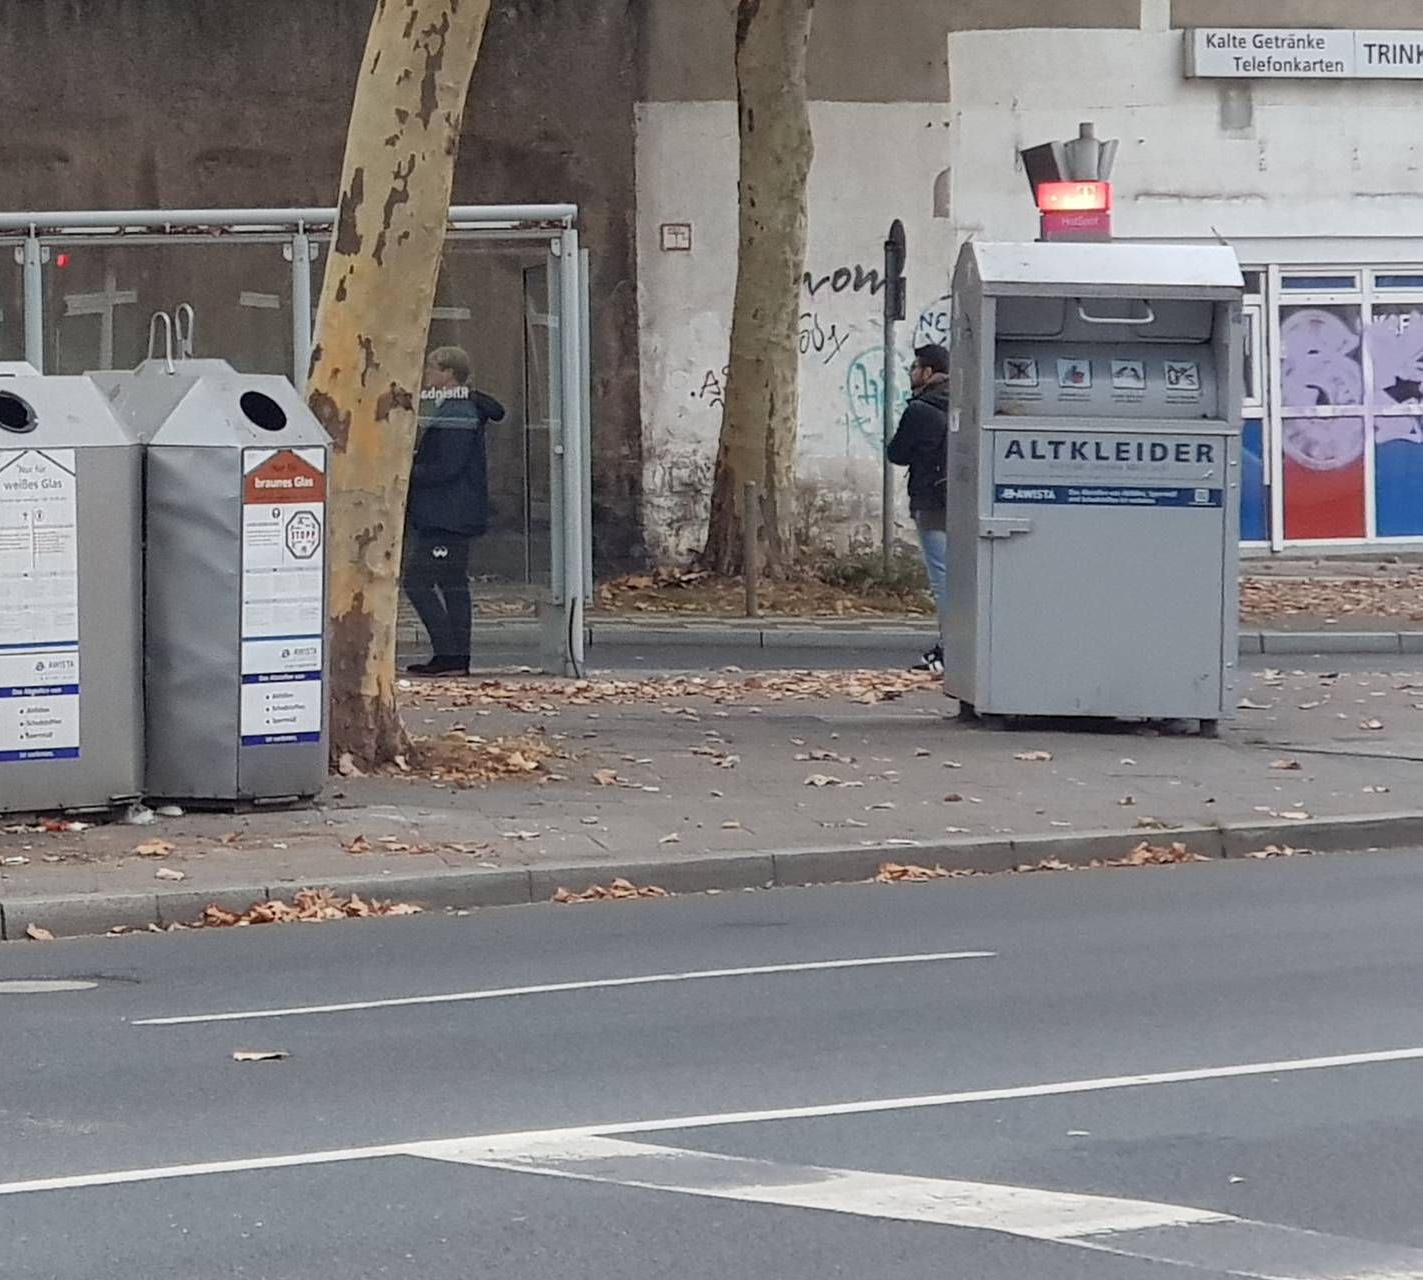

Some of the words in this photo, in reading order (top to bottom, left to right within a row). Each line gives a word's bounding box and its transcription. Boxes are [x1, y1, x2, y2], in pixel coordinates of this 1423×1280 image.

[1205, 33, 1247, 49] Kalte
[1252, 33, 1326, 50] Getränke
[1233, 56, 1345, 73] Telefonkarten
[1004, 438, 1216, 464] ALTKLEIDER
[41, 477, 64, 489] Glas
[293, 475, 314, 488] Glas
